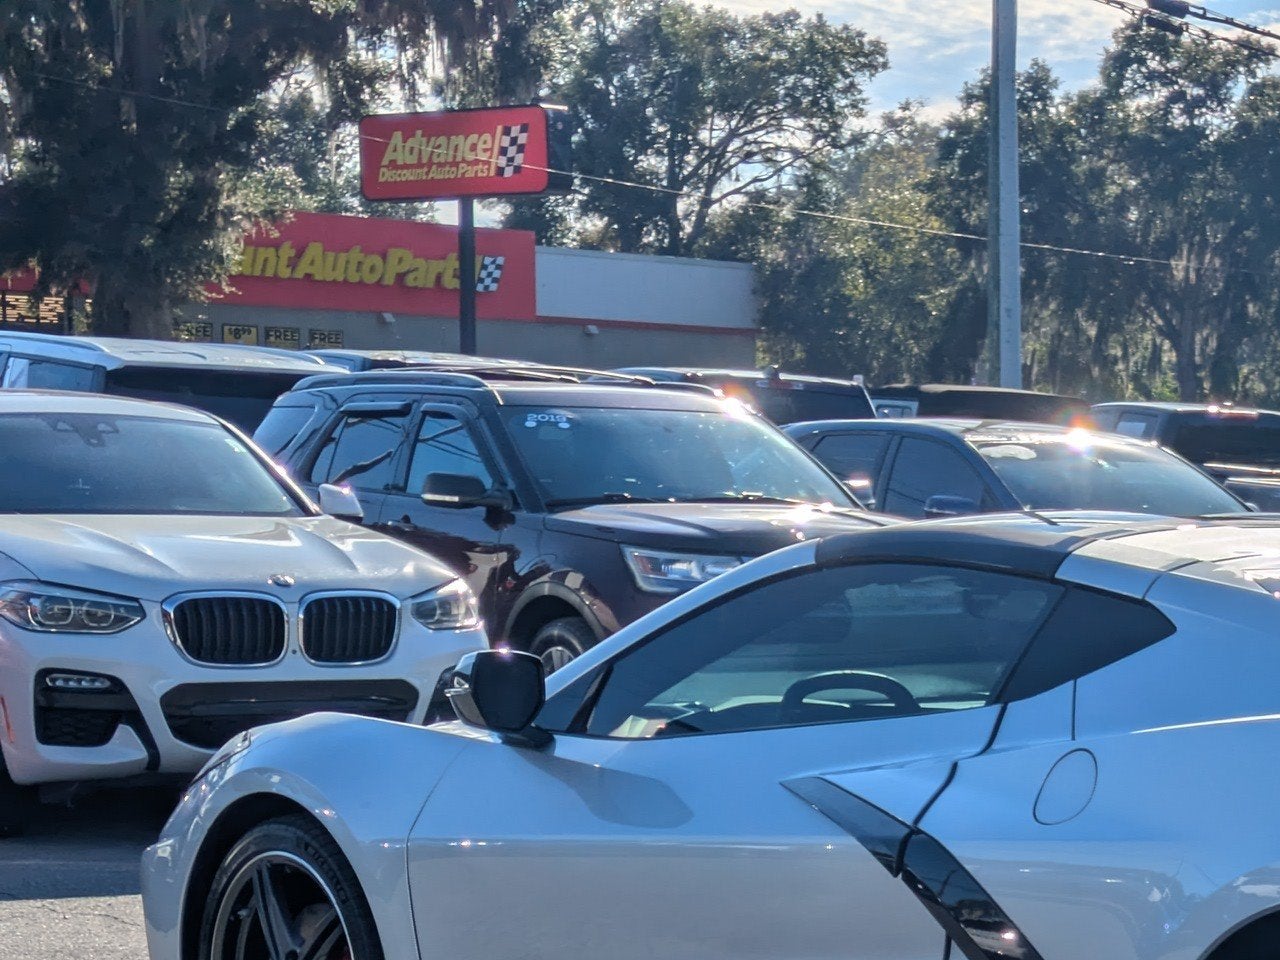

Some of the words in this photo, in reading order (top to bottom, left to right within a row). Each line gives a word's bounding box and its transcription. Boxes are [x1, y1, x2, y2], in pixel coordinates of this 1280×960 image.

[381, 130, 492, 165] Advance
[379, 165, 429, 182] Discount
[428, 164, 457, 180] Auto
[458, 162, 490, 178] Parts
[381, 248, 460, 290] Part
[267, 327, 299, 341] FREE
